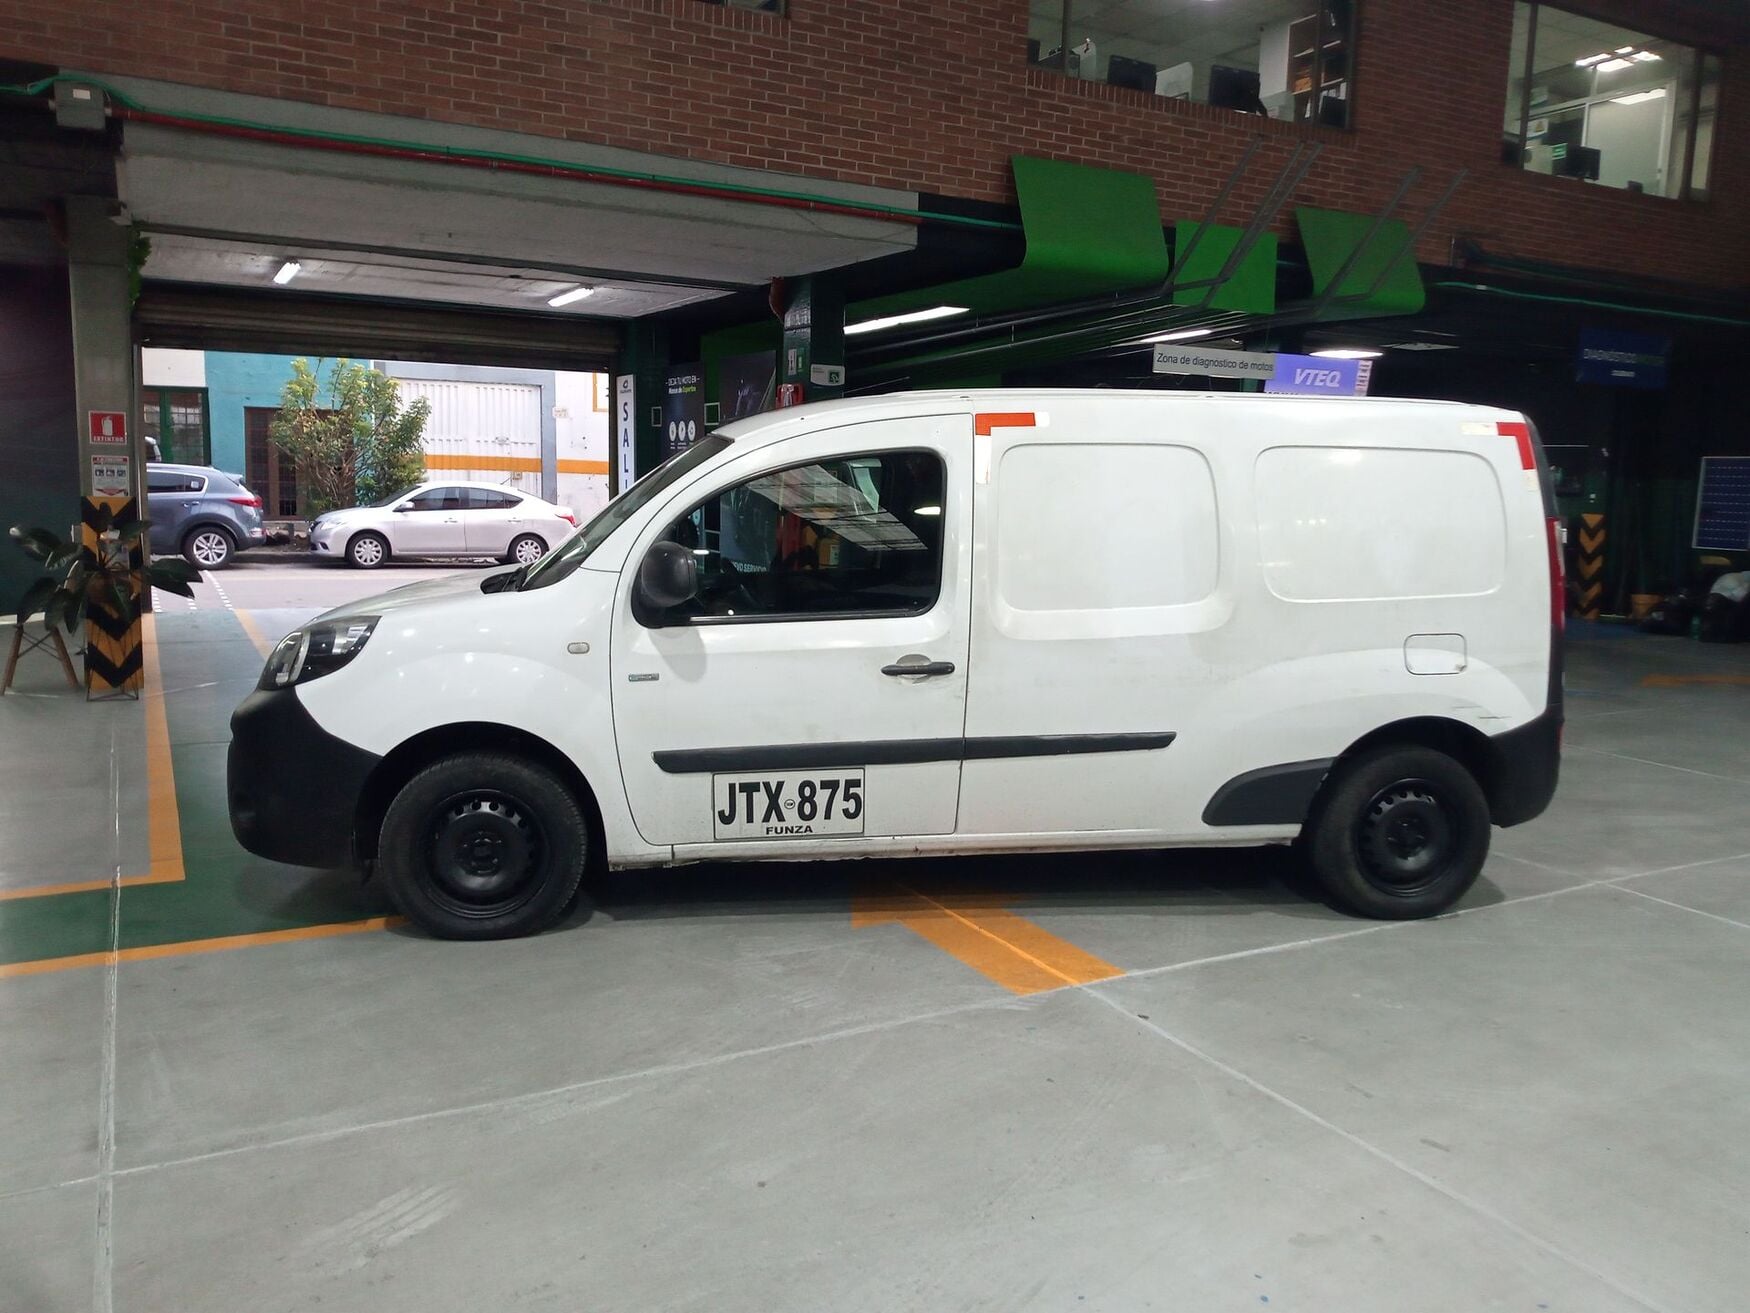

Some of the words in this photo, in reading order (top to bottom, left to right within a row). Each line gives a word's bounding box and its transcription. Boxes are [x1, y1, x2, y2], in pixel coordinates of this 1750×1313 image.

[1157, 353, 1178, 364] Zona
[1180, 355, 1190, 365] de
[1192, 356, 1237, 369] diagnostico
[1239, 359, 1249, 370] de
[1250, 362, 1274, 372] motos
[1294, 368, 1341, 388] VTEQ
[717, 781, 786, 825] JTX
[797, 778, 862, 822] 875
[765, 825, 813, 835] FUNZA
